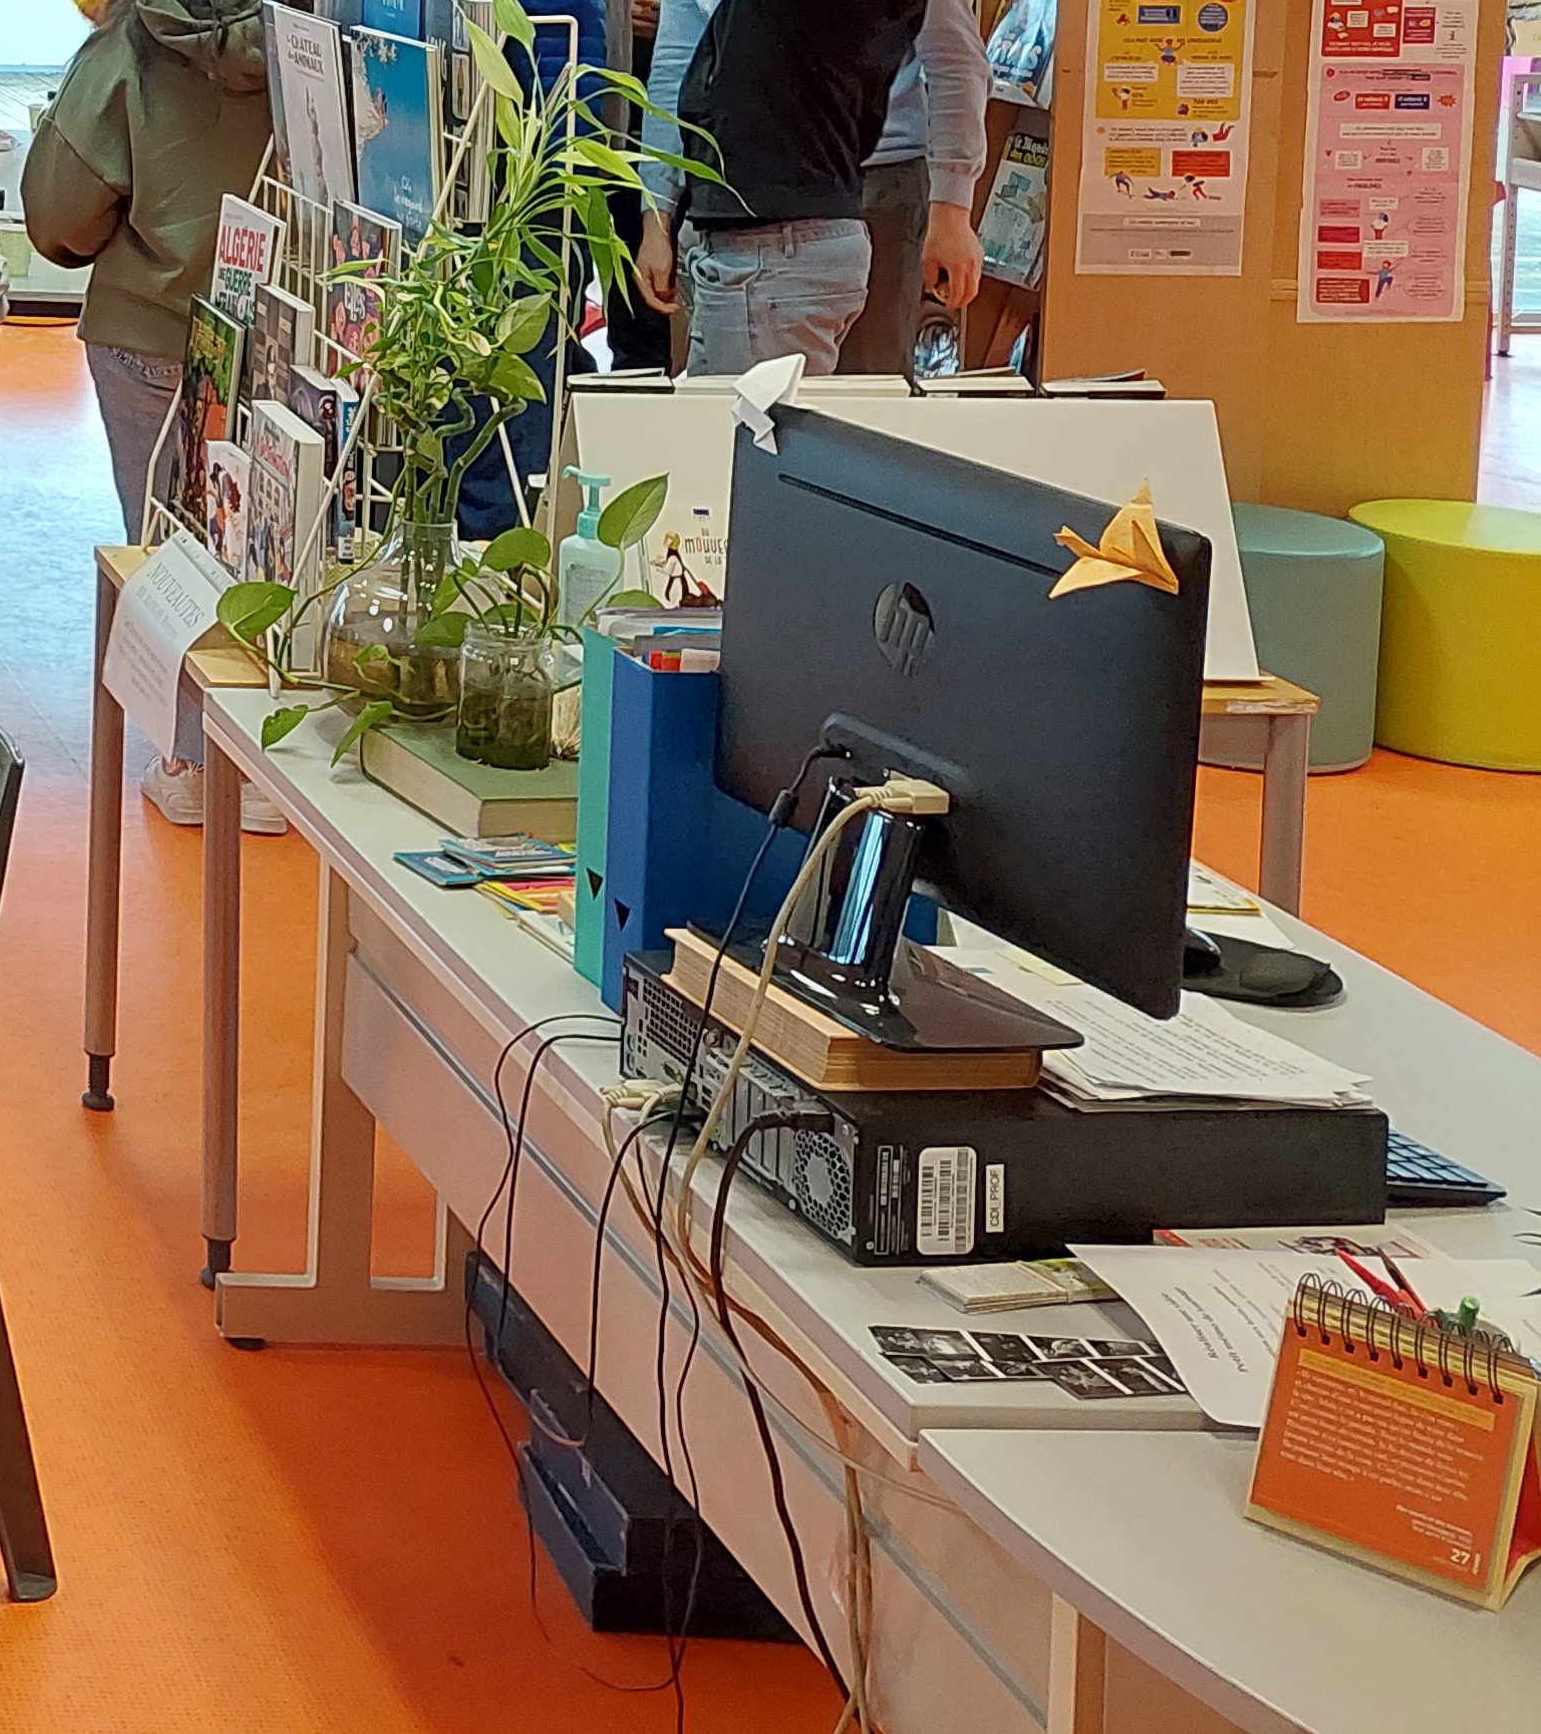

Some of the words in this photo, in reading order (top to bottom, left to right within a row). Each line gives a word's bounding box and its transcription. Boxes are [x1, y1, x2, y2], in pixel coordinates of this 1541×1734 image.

[218, 225, 267, 274] ALGÉRIE
[147, 562, 205, 628] NOUVEAUTES
[1449, 1548, 1471, 1565] 27
